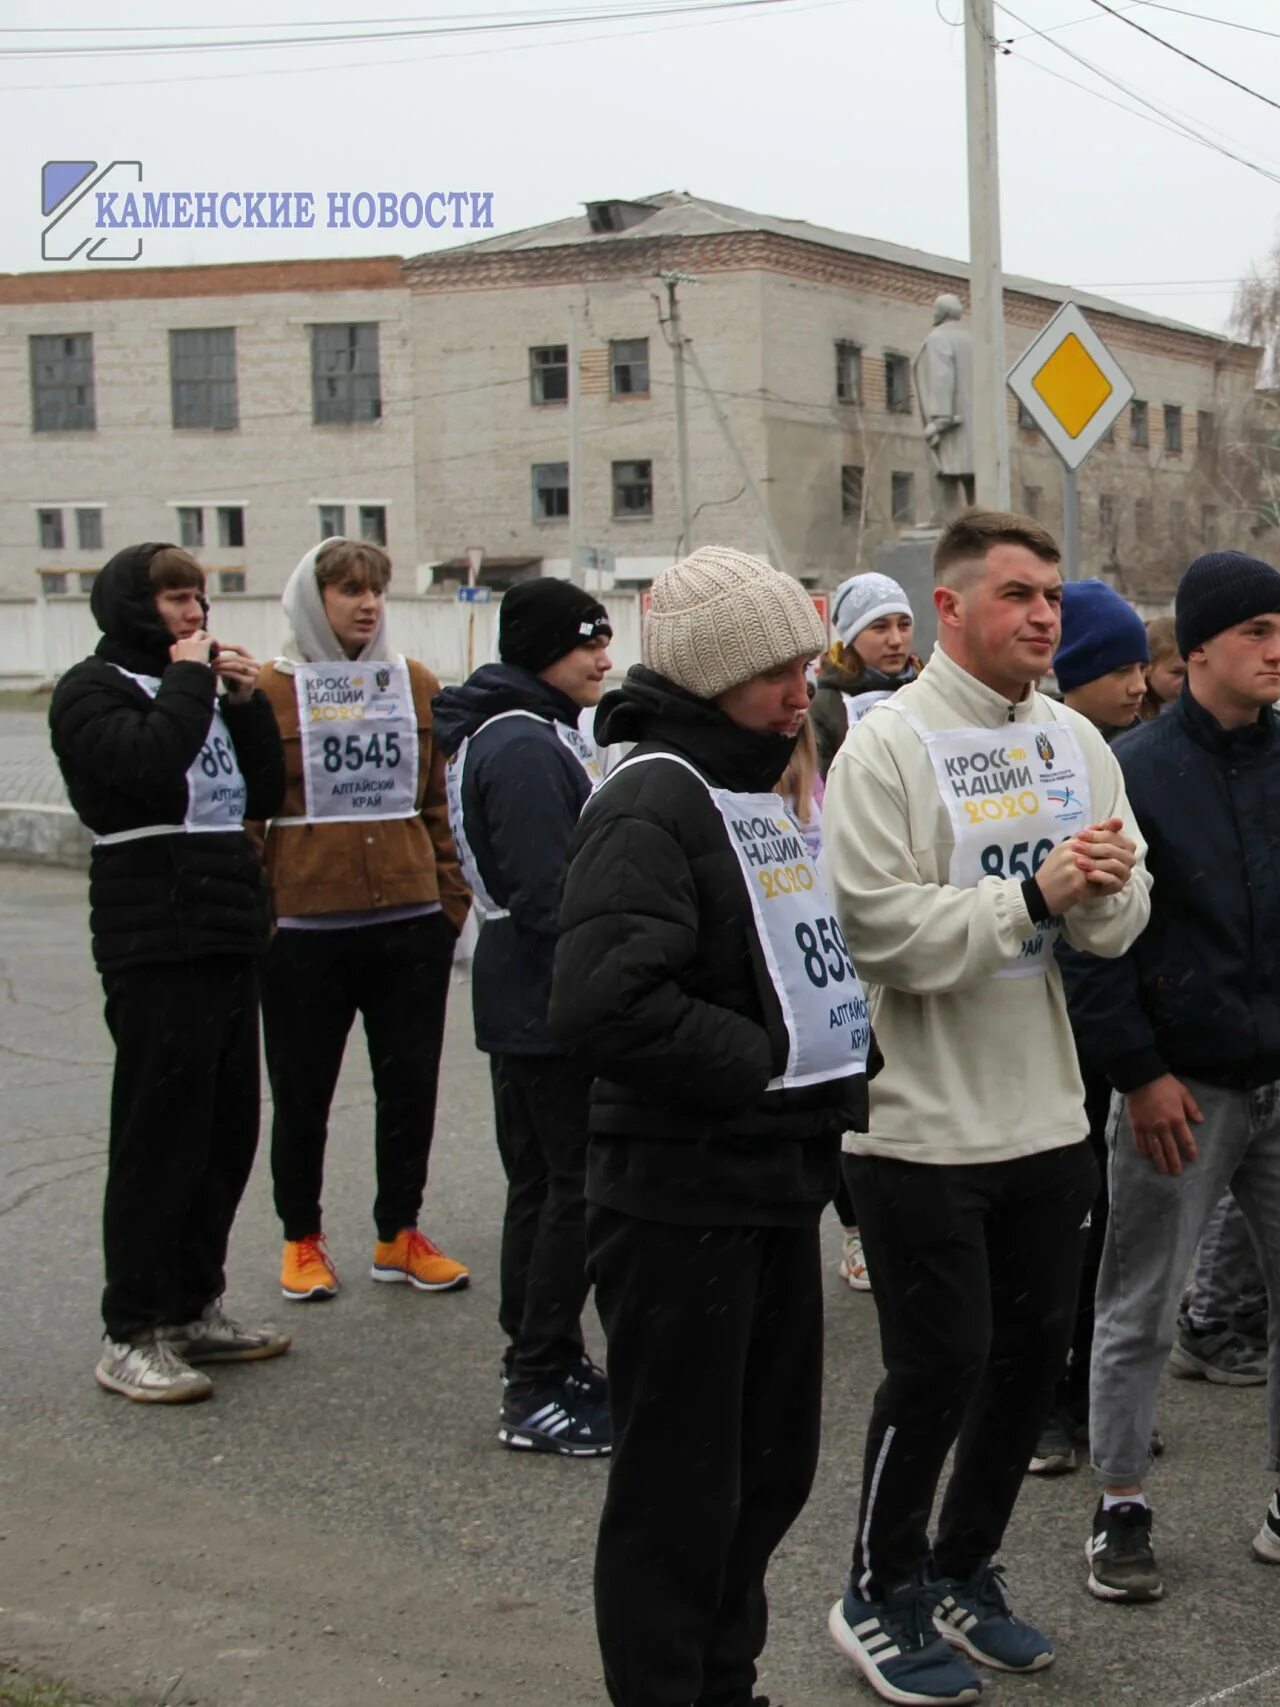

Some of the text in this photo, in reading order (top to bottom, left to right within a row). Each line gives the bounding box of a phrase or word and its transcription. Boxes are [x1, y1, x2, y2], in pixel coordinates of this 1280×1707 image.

[306, 677, 350, 691] КРОСС
[307, 689, 365, 705] НАЦИИ
[310, 704, 366, 721] 2020
[323, 732, 401, 773] 8545
[944, 747, 1011, 778] КРОСС
[950, 765, 1033, 798] НАЦИИ
[963, 790, 1040, 825] 2020
[741, 836, 804, 867] НАЦИИ
[758, 863, 815, 899] 2020
